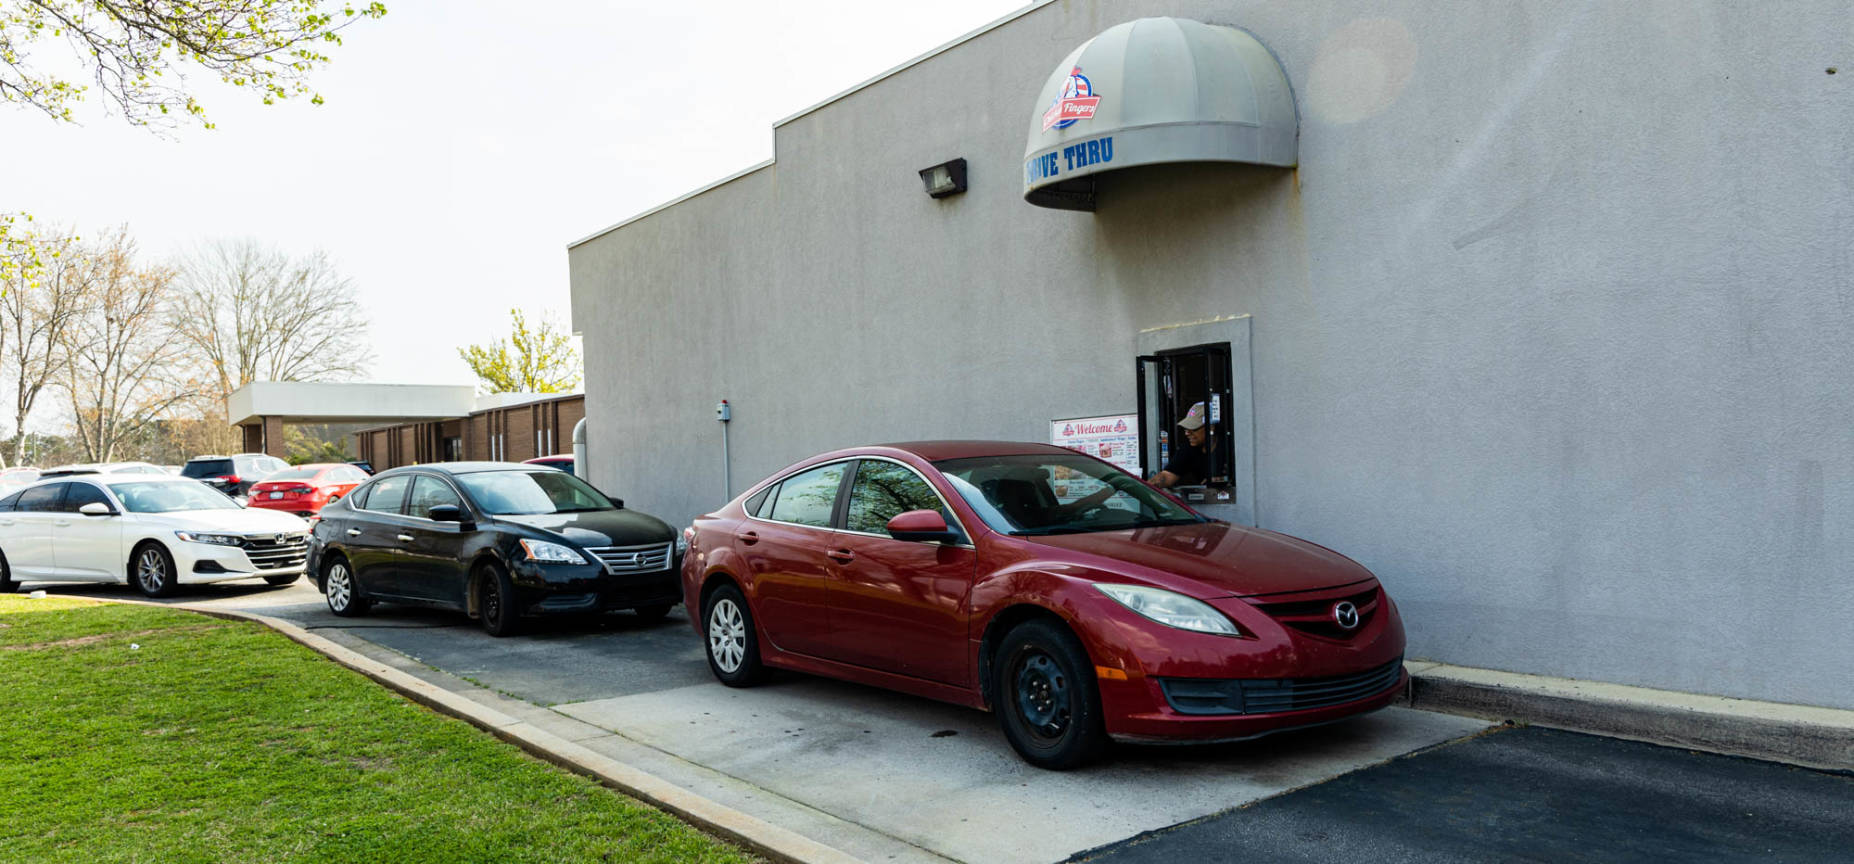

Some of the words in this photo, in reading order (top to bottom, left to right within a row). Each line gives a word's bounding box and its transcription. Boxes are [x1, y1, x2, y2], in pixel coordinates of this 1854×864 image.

[1064, 103, 1095, 114] Fingers
[1064, 137, 1113, 171] THRU
[1075, 423, 1113, 434] Welcome
